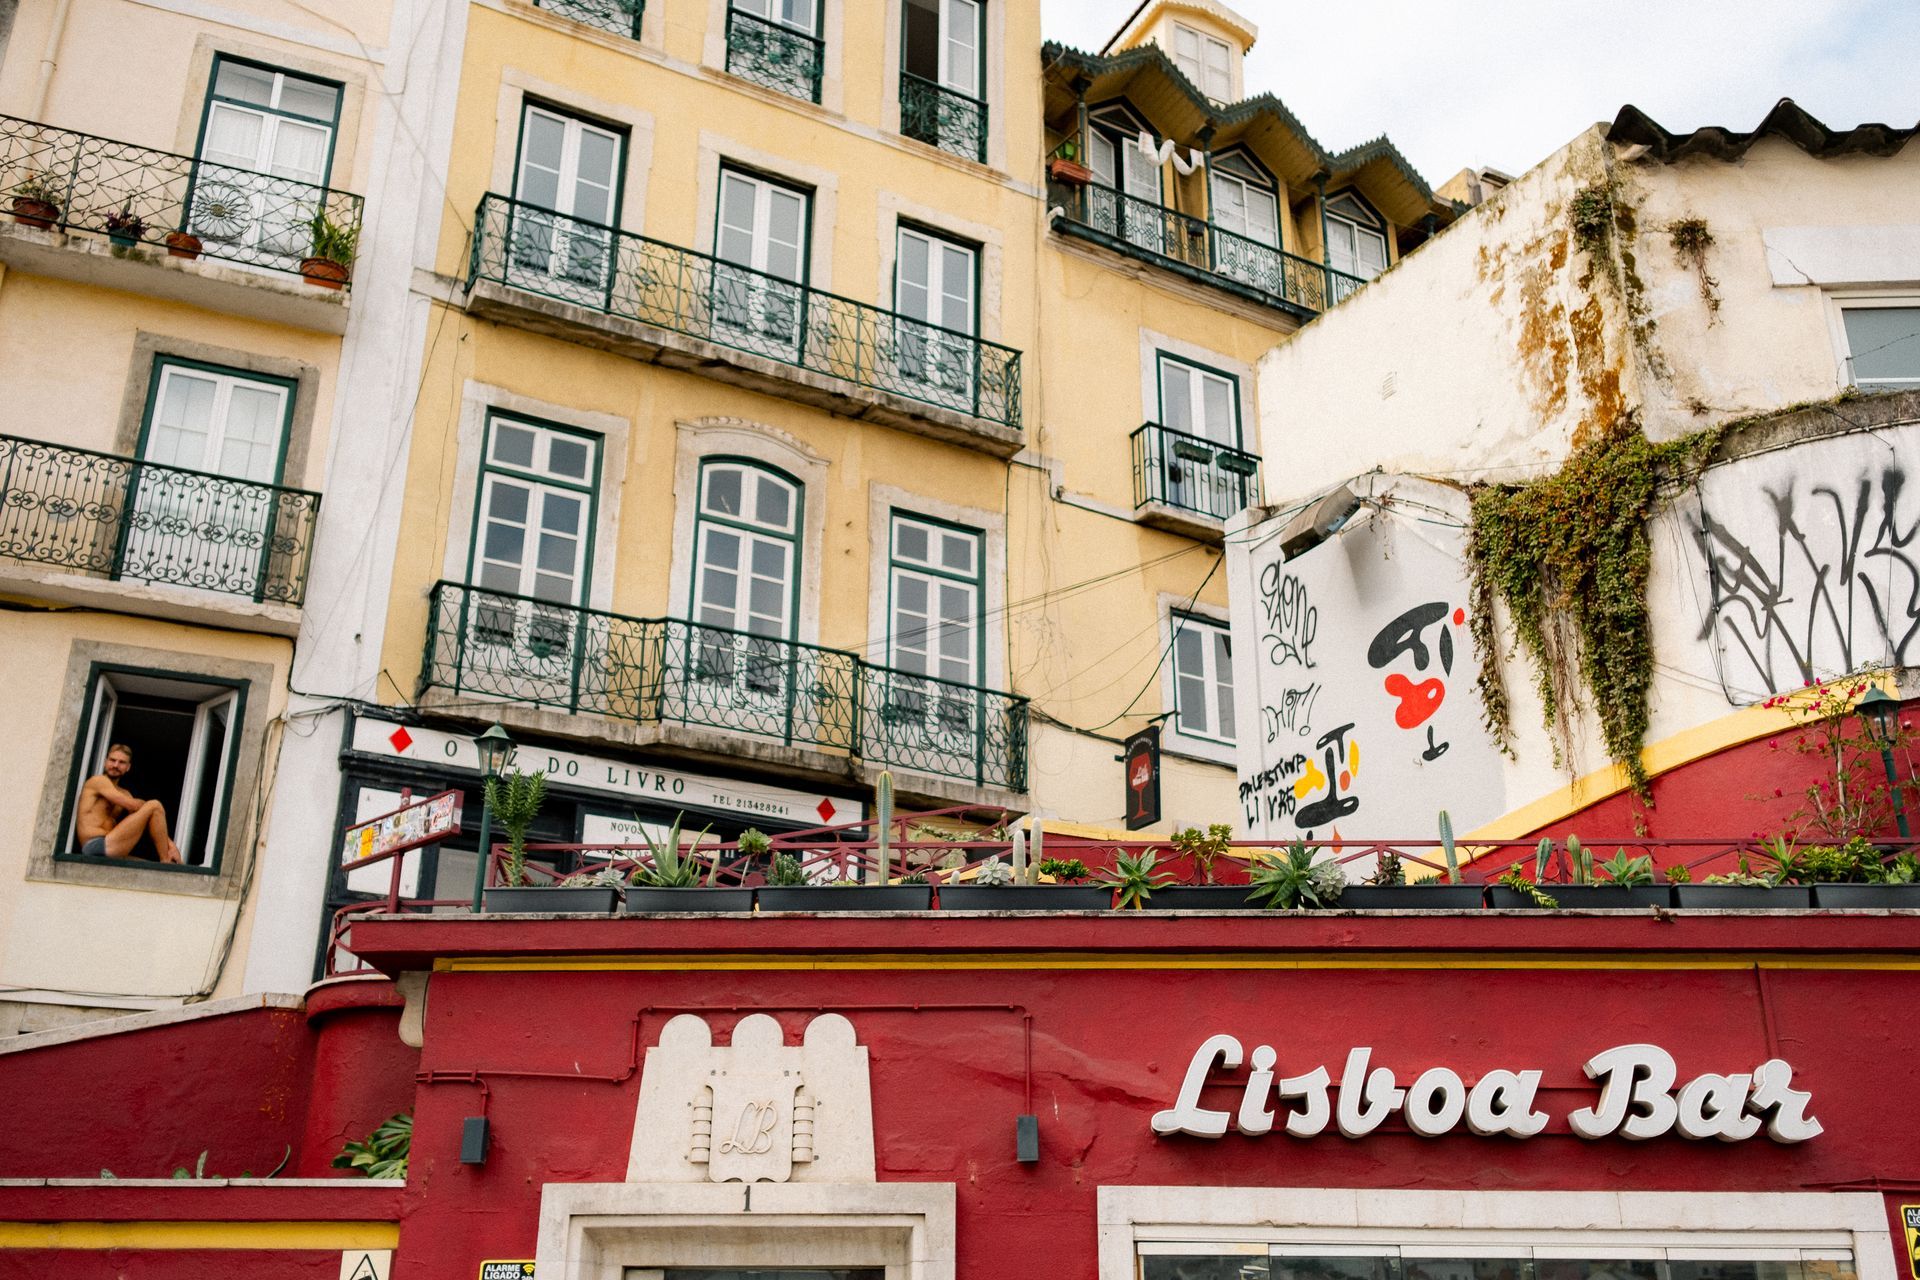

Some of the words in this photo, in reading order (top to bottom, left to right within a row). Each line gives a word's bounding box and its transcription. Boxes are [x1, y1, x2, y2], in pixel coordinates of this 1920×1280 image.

[445, 740, 457, 757] O
[547, 756, 579, 776] DO
[607, 766, 685, 795] LIVRO
[712, 794, 731, 806] TEL
[1150, 1034, 1550, 1140] Lisboa
[1568, 1043, 1825, 1145] Bar
[743, 1185, 752, 1212] 1
[484, 1272, 520, 1280] LIGADO
[485, 1264, 520, 1272] ALARME
